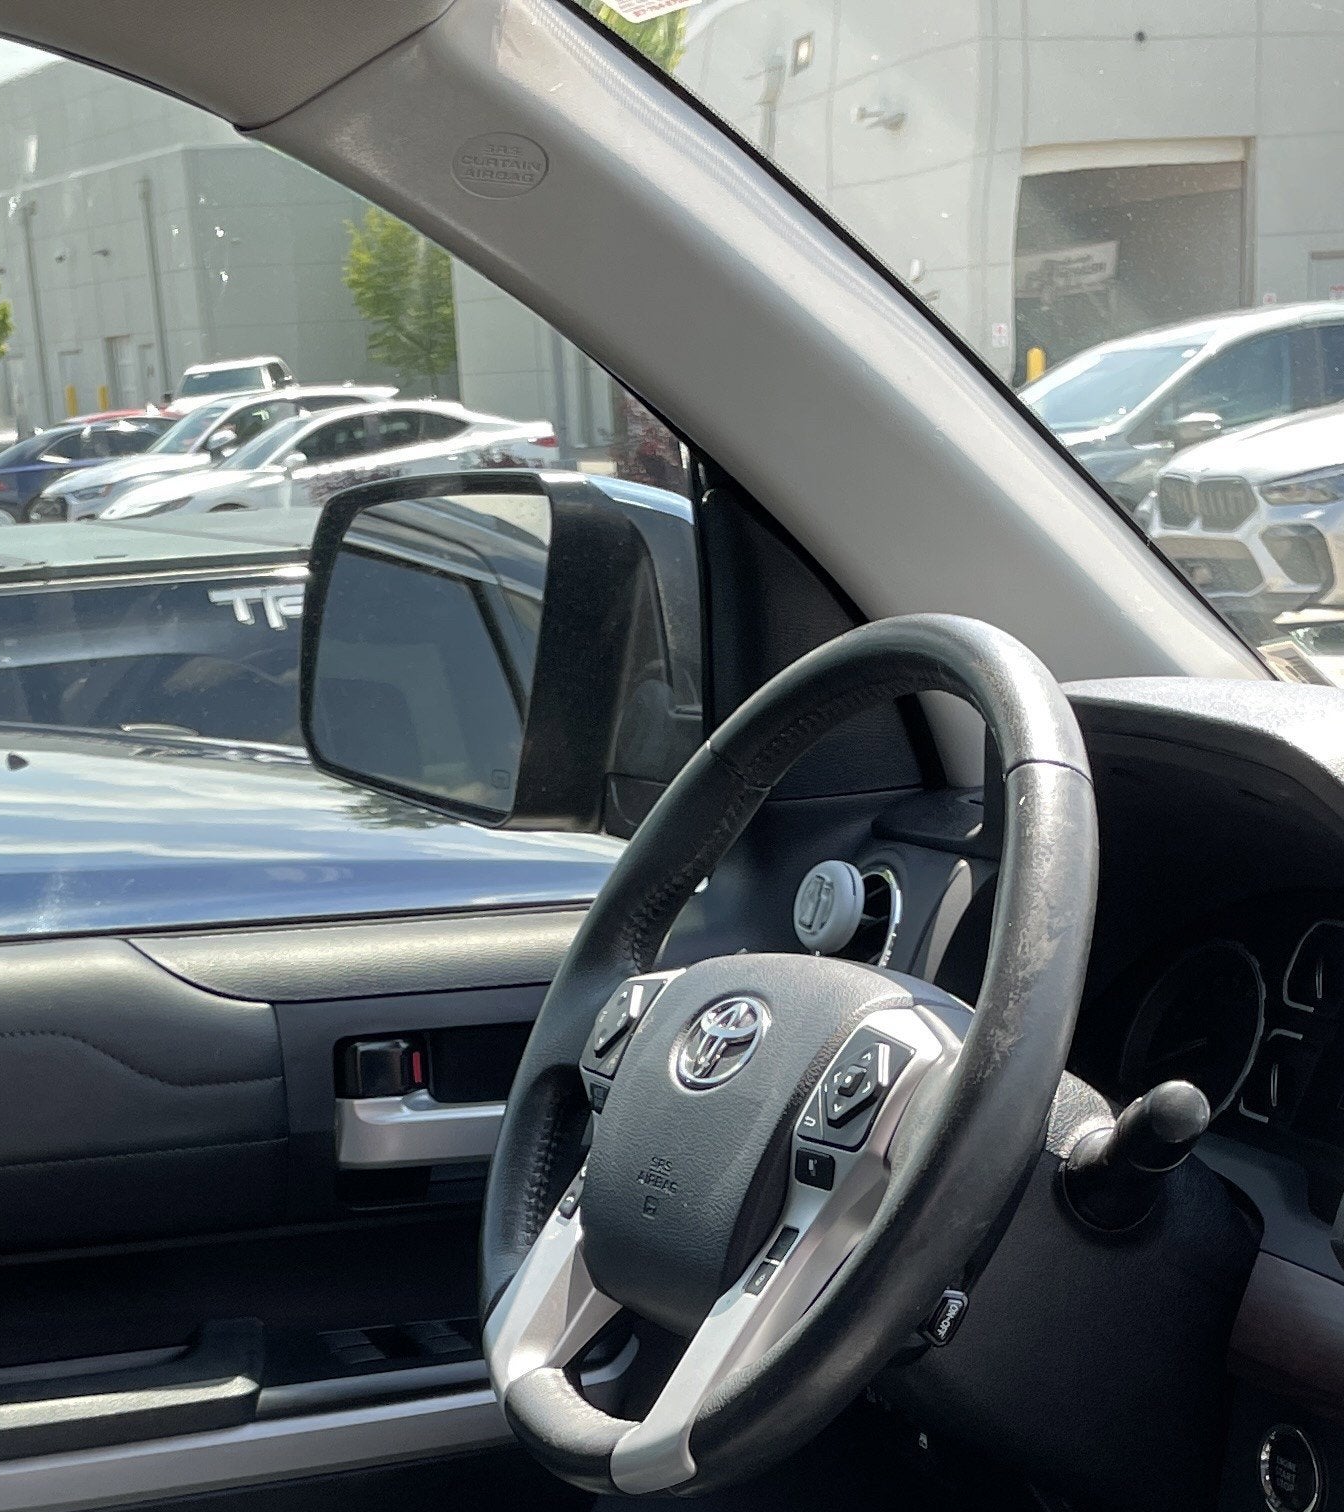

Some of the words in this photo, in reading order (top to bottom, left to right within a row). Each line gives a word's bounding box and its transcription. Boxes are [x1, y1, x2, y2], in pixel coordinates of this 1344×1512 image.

[461, 155, 541, 172] CURTAIN
[464, 168, 535, 184] AIRBAG
[636, 1171, 678, 1193] AIRBAG
